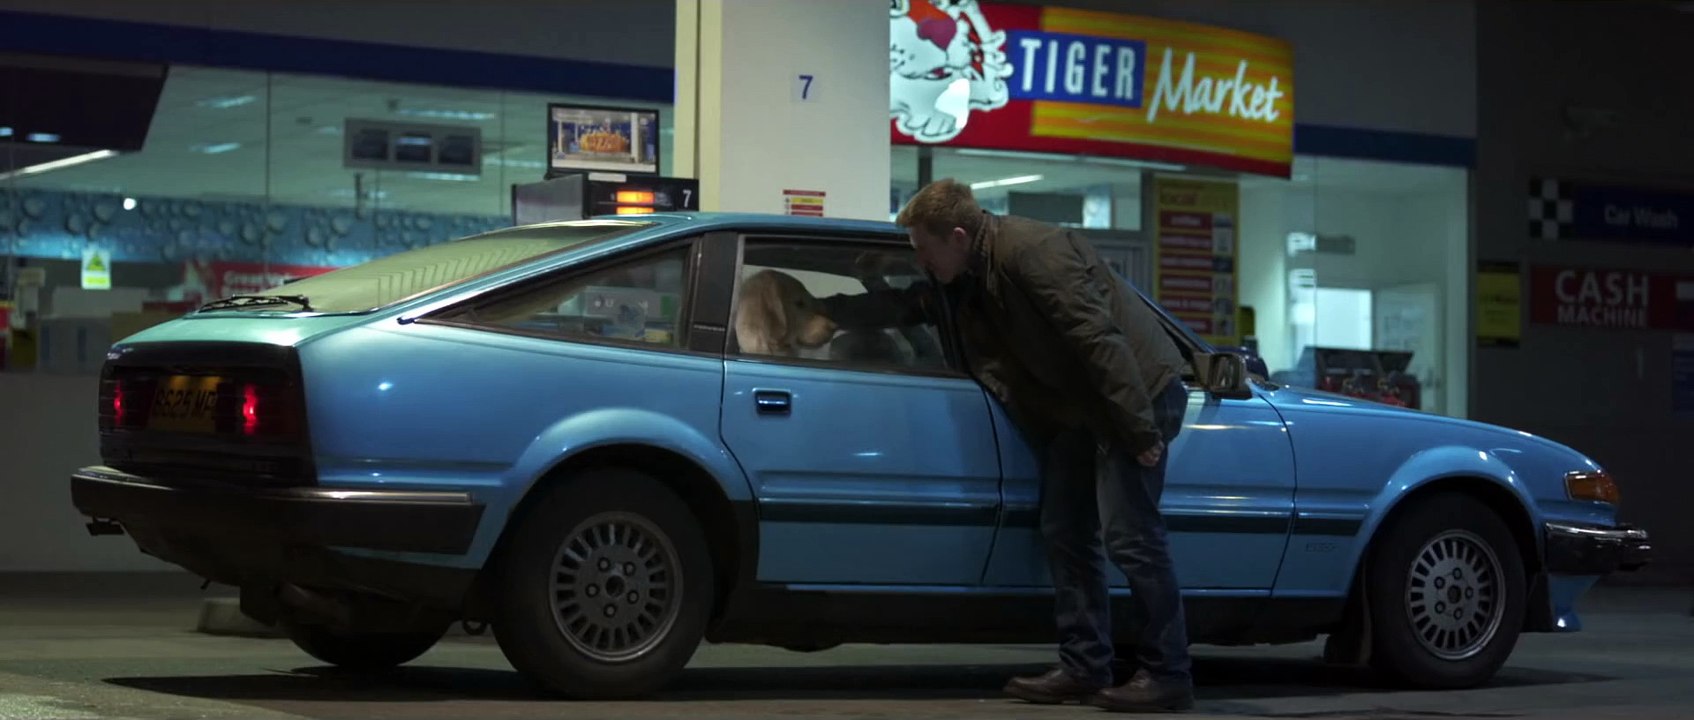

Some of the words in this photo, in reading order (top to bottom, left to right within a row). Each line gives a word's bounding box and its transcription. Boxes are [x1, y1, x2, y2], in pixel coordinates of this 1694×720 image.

[798, 75, 814, 100] 7
[1019, 38, 1137, 100] TIGER
[1146, 47, 1284, 124] Market
[682, 188, 693, 209] 7
[1604, 205, 1630, 225] Car
[1633, 207, 1679, 229] Wash
[1554, 269, 1650, 308] CASH
[1556, 305, 1649, 328] MACHINE
